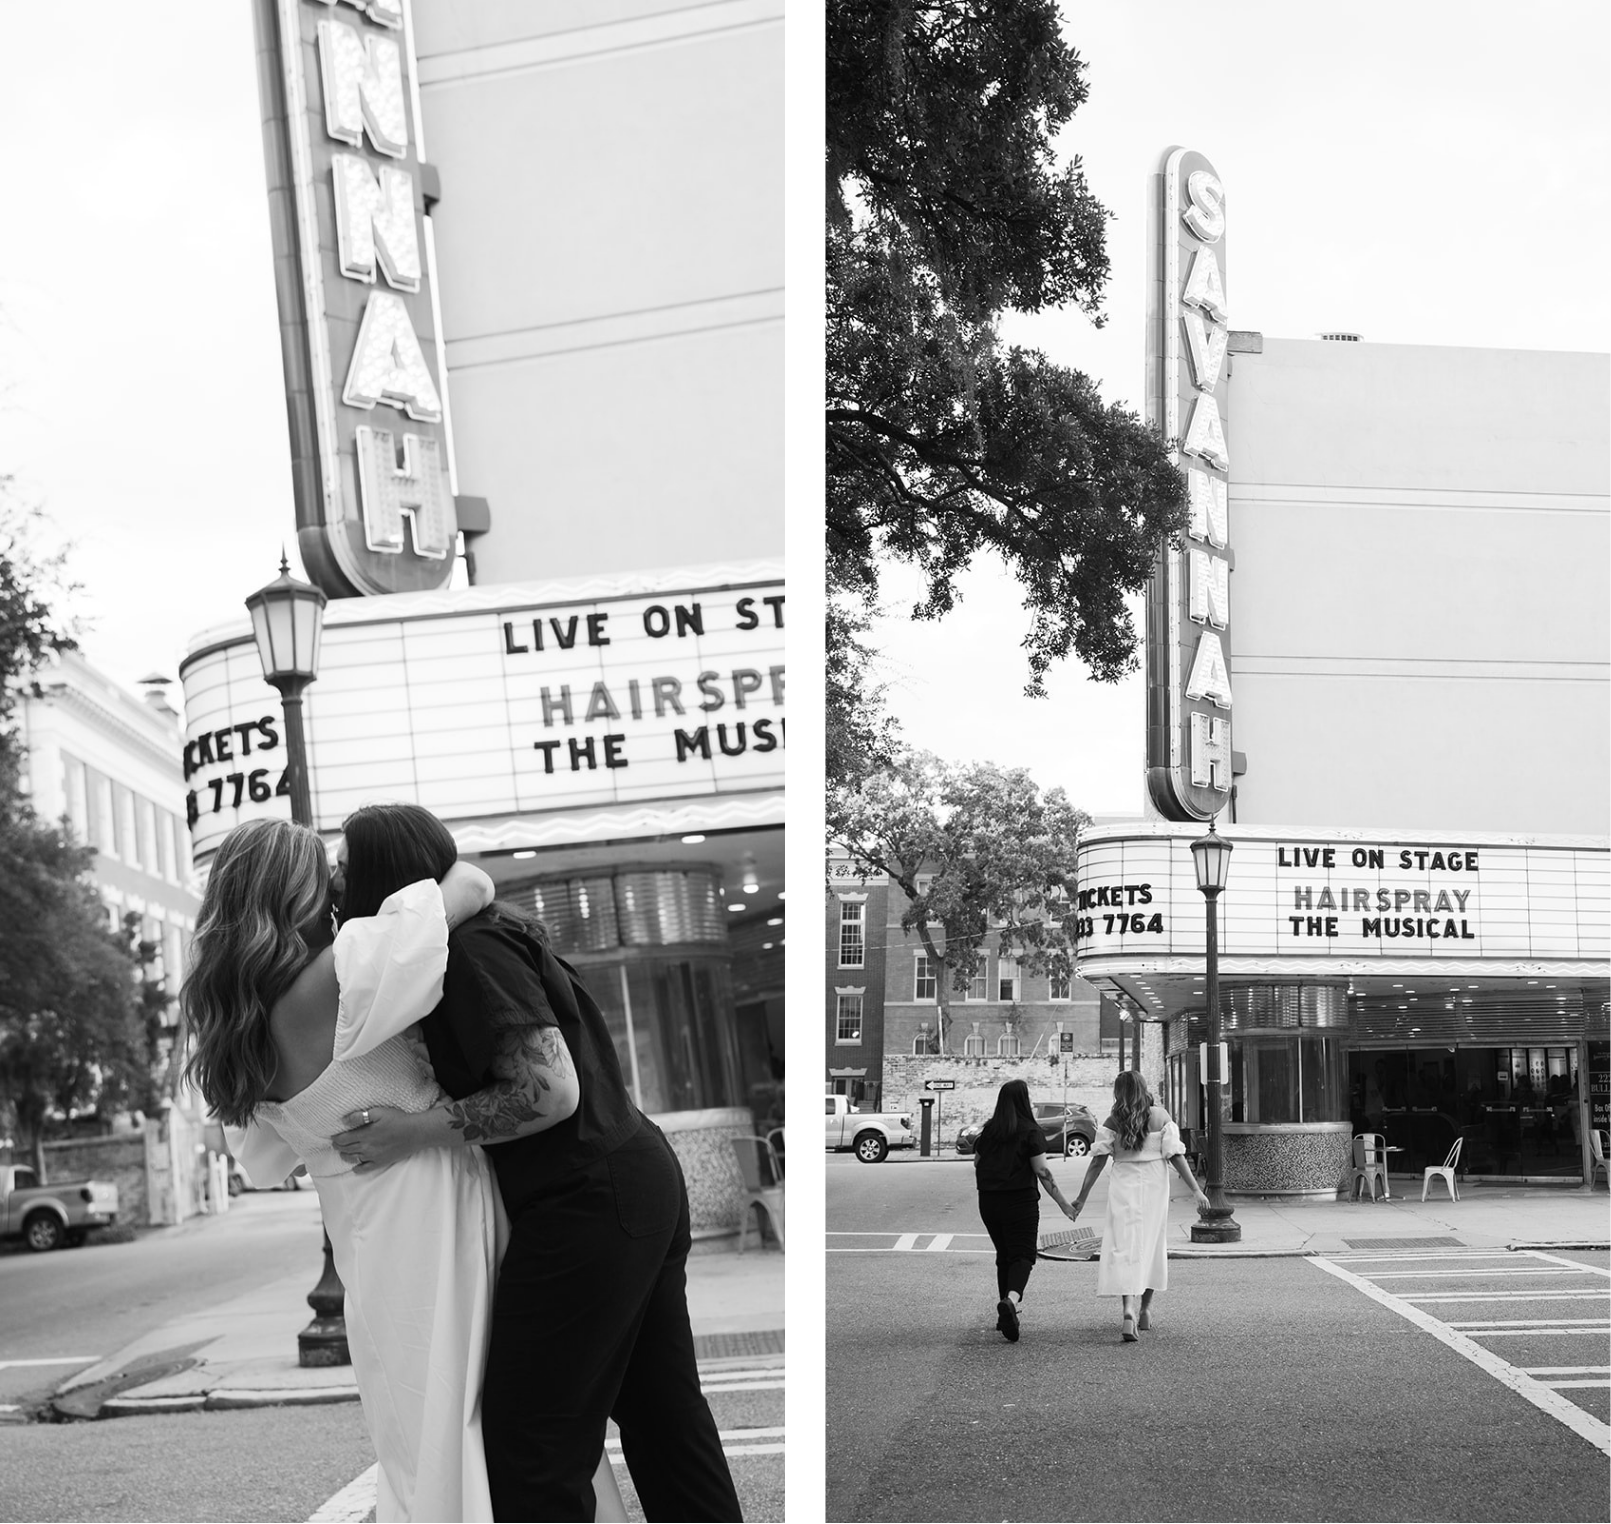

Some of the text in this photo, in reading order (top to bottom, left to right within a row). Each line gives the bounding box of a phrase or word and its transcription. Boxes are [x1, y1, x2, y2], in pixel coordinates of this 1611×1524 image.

[317, 0, 448, 560] NNAH
[1181, 169, 1232, 793] SAVANNAH
[503, 612, 611, 655] LIVE
[643, 603, 705, 638] ON
[534, 733, 629, 774] THE
[1278, 847, 1479, 872] LIVE ON STAGE
[1294, 885, 1471, 914] HAIRSPRAY
[1103, 912, 1164, 935] 7764
[1289, 916, 1475, 939] THE MUSICAL
